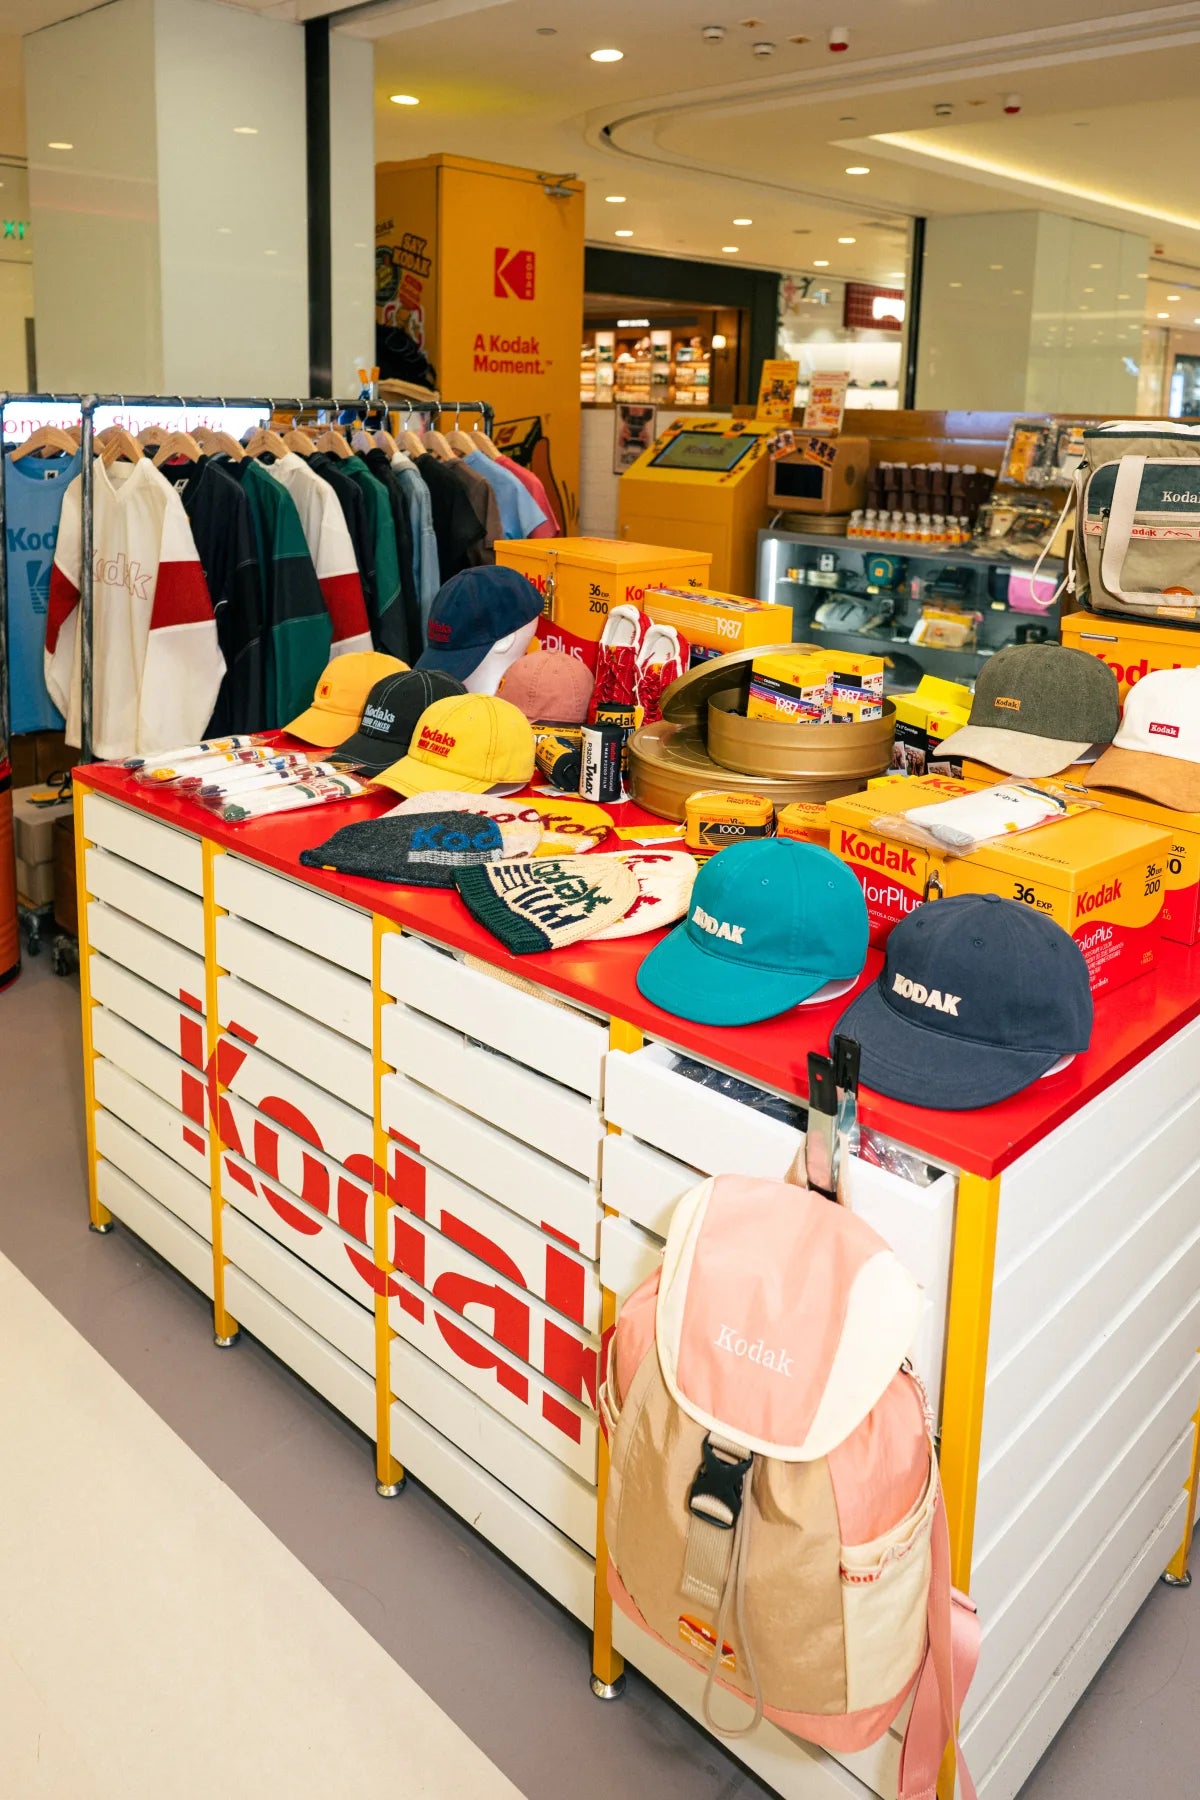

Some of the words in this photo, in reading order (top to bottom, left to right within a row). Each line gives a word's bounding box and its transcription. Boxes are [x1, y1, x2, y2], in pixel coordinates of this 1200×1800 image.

[392, 246, 431, 278] KODAK
[525, 254, 533, 298] KODAK
[473, 333, 486, 352] A
[489, 334, 540, 355] Kodak
[1161, 491, 1200, 504] Koda
[7, 525, 58, 552] Kod
[589, 583, 601, 597] 36
[589, 600, 609, 615] 200
[716, 617, 742, 639] 1987
[540, 634, 583, 662] rPlus
[775, 696, 799, 715] 1987
[836, 687, 860, 704] 1987
[996, 699, 1018, 708] Kodak
[373, 719, 391, 731] FINISH
[597, 713, 636, 727] Kodak
[1150, 724, 1177, 735] Kodak
[429, 743, 450, 755] FINISH
[798, 803, 826, 811] Koda
[410, 820, 503, 851] Kod
[720, 825, 745, 835] 1000
[783, 827, 808, 837] Kodak
[840, 829, 917, 876] Kodak
[1145, 864, 1156, 878] 36
[862, 876, 924, 914] lorPlus
[1013, 882, 1035, 904] 36
[1036, 900, 1054, 911] EXP.
[1076, 878, 1122, 917] Kodak
[1144, 879, 1160, 897] 200
[691, 905, 747, 945] KODAK
[892, 973, 962, 1017] KODAK
[179, 988, 617, 1445] Kodak
[713, 1323, 796, 1379] Kodak
